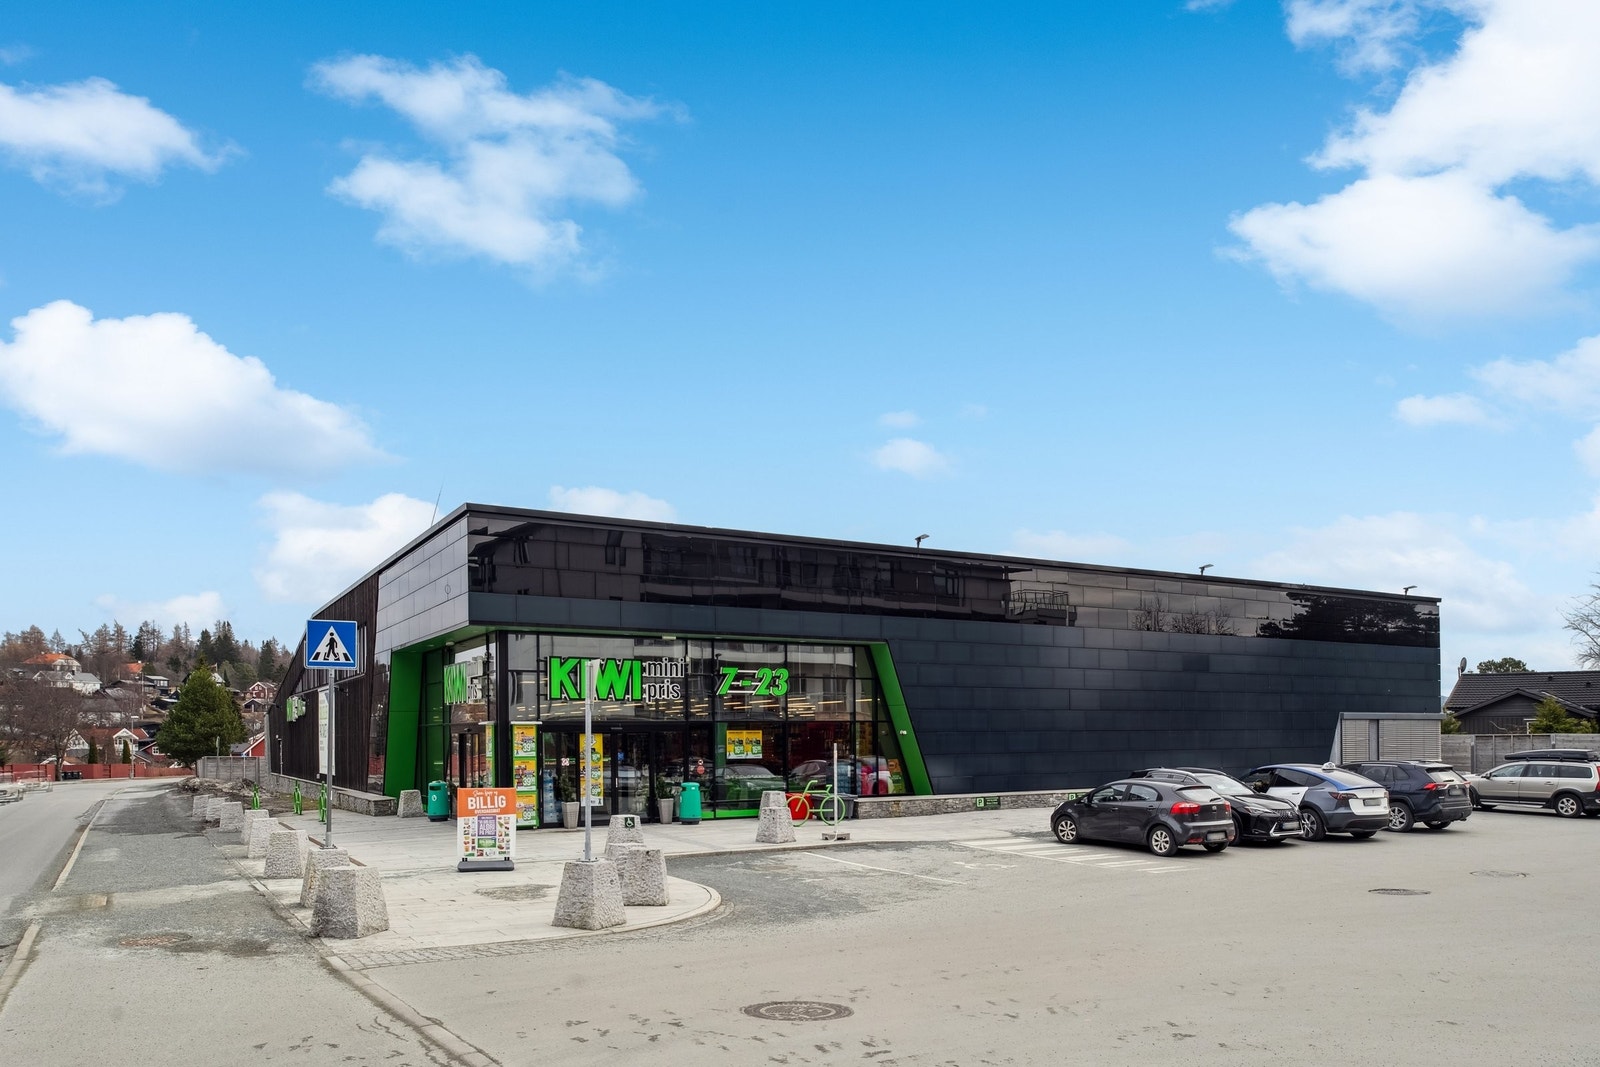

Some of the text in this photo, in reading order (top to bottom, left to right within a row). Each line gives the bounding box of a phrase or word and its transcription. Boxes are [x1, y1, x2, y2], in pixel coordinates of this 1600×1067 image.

[549, 656, 643, 701] KIWI
[646, 657, 685, 678] mini
[646, 679, 681, 704] pris
[468, 796, 506, 809] BILLIG
